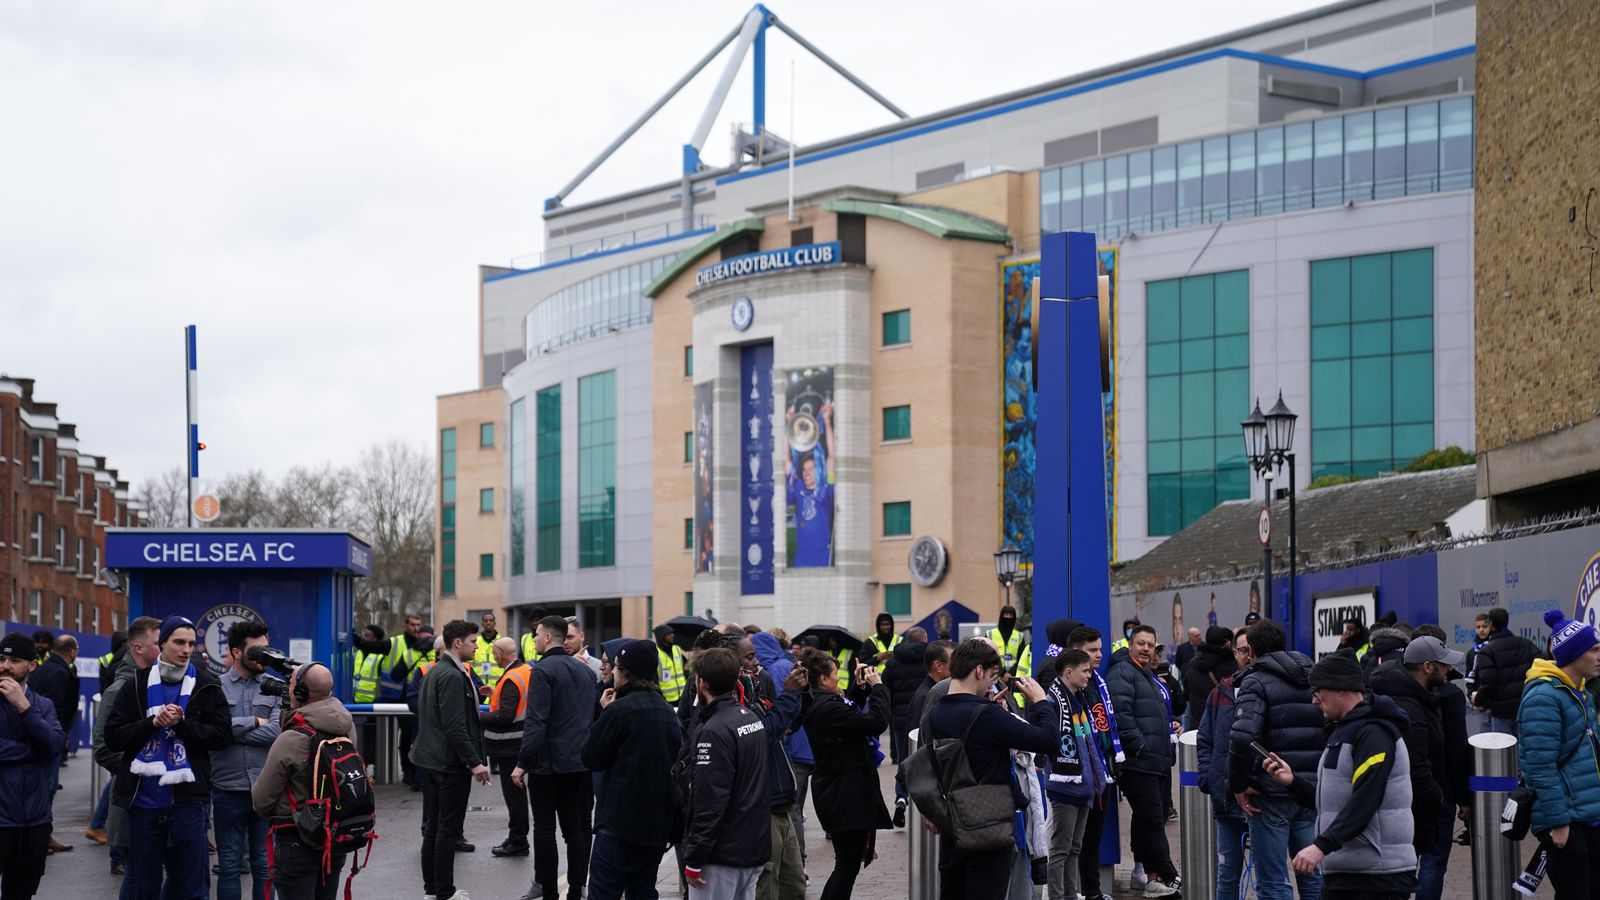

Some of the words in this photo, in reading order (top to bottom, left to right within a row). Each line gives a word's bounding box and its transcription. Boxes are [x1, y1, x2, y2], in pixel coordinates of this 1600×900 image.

[696, 263, 730, 287] CHELSEA
[730, 251, 792, 274] FOOTBALL
[794, 246, 833, 265] CLUB
[1260, 518, 1268, 534] 10
[143, 542, 257, 563] CHELSEA
[264, 542, 296, 562] FC
[1460, 588, 1499, 609] Willkommen
[206, 606, 256, 623] CHELSEA
[737, 720, 765, 737] PETRONA
